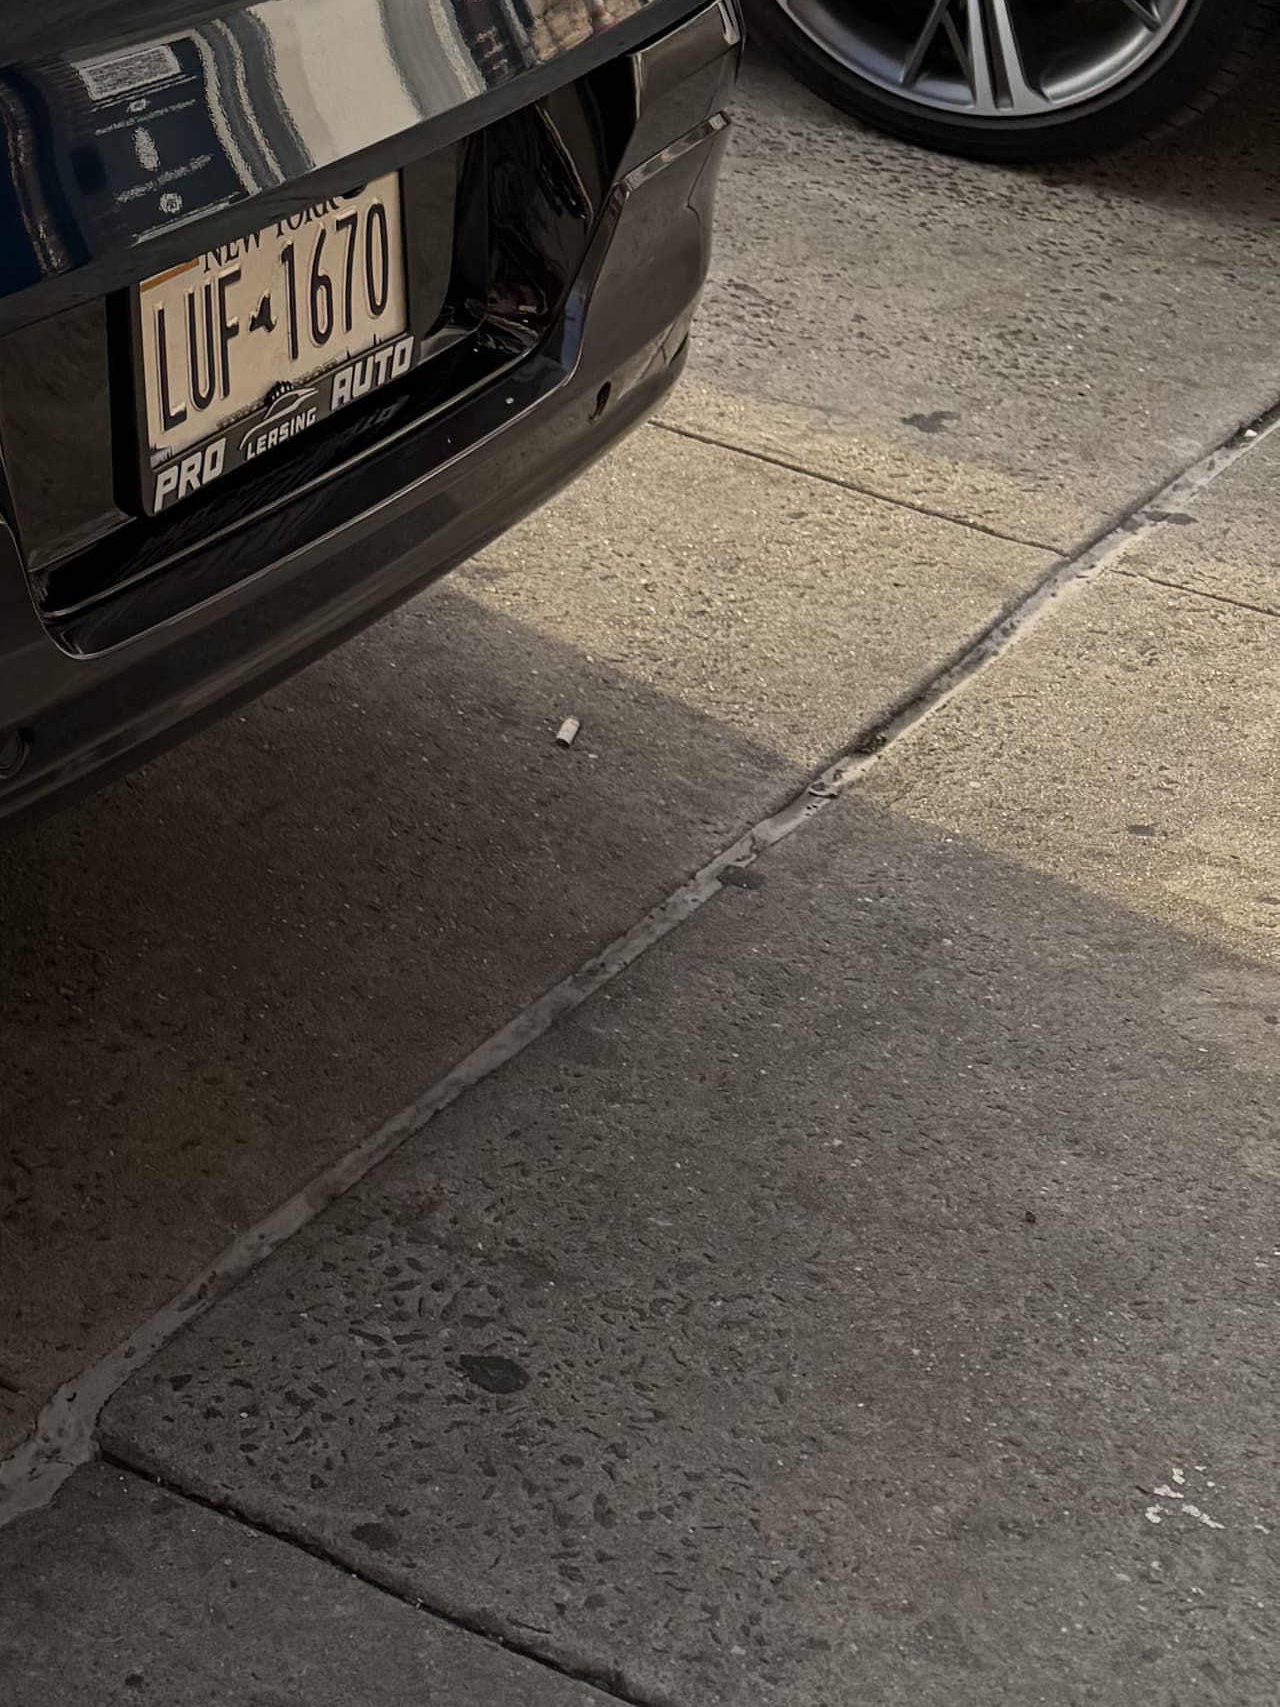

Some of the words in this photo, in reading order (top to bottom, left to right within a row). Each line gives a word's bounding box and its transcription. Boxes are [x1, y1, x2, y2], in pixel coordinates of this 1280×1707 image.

[153, 265, 243, 434] LUF
[279, 197, 390, 362] 1670
[153, 437, 227, 515] PRO
[246, 406, 318, 462] LEASING
[330, 335, 415, 412] AUTO
